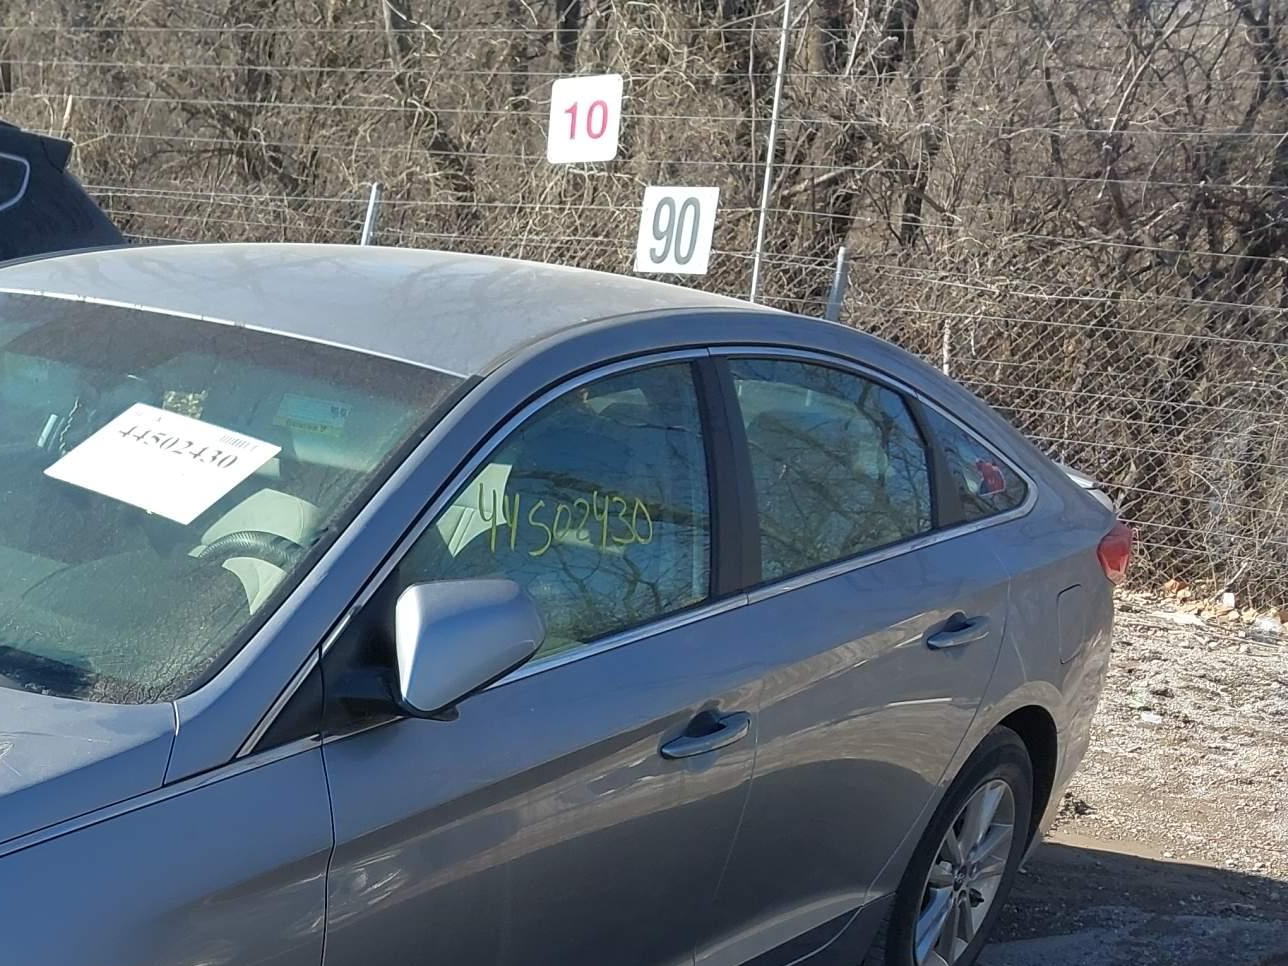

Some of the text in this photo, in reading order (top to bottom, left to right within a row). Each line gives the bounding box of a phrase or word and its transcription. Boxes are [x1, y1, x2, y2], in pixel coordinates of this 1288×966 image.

[564, 99, 609, 140] 10
[649, 196, 701, 265] 90
[118, 425, 238, 468] 44502430
[478, 482, 653, 556] 44502430
